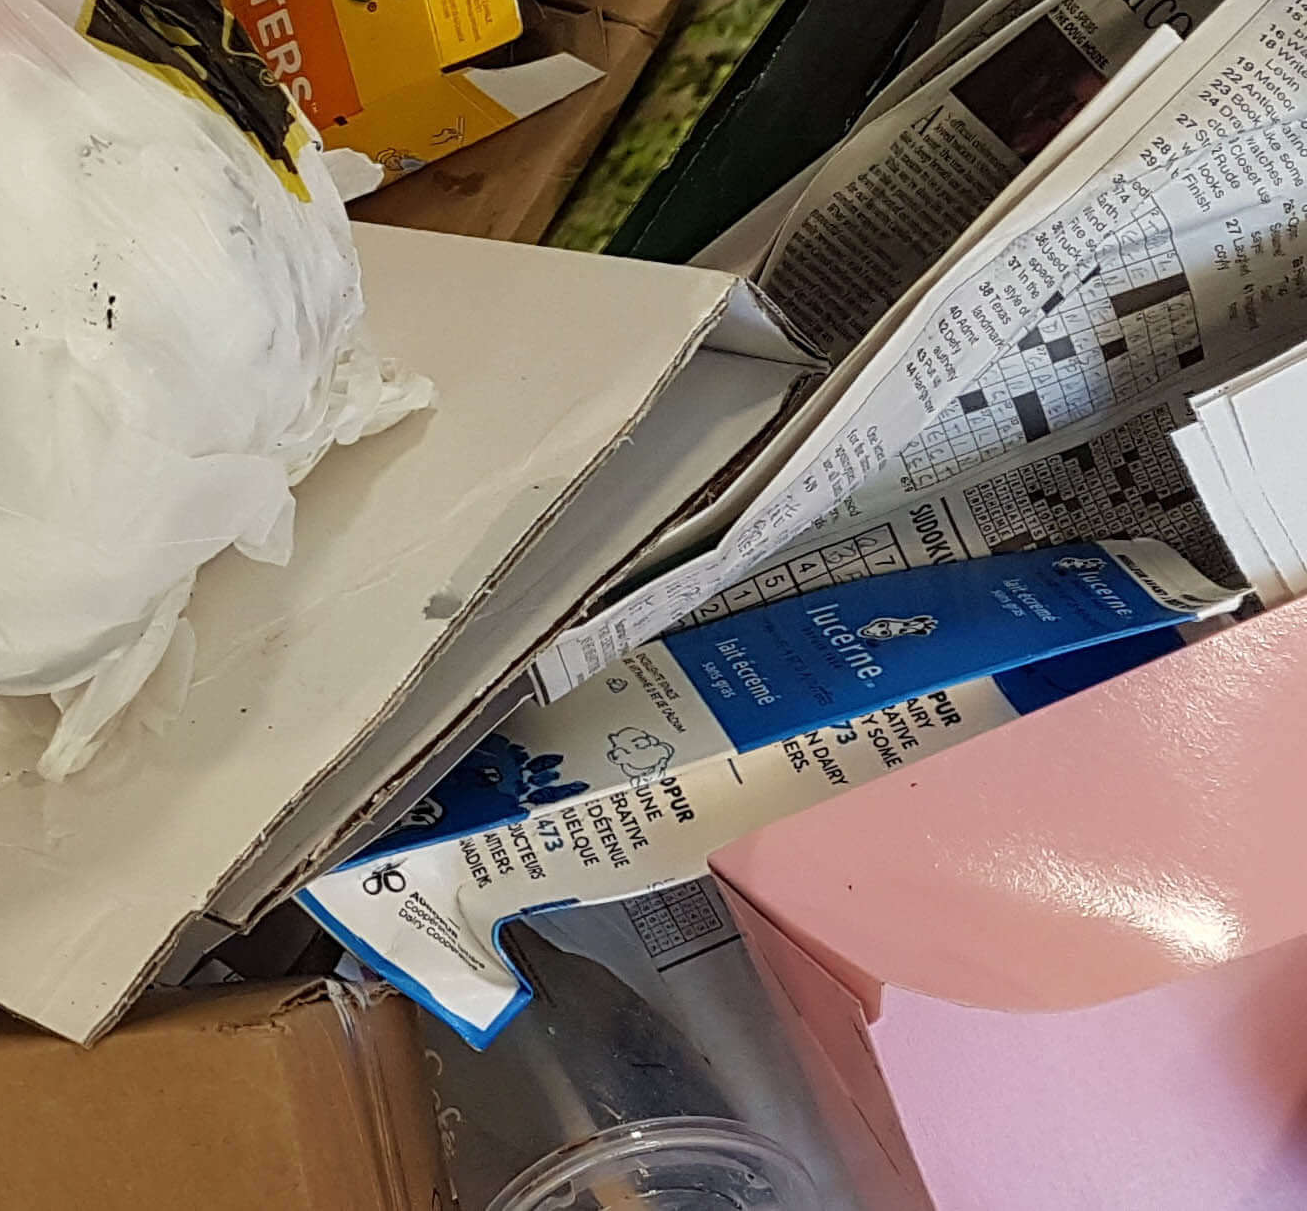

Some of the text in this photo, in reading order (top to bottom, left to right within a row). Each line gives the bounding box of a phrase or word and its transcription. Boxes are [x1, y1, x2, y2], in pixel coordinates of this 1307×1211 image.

[1221, 67, 1244, 85] 22
[1236, 56, 1255, 72] 19
[1198, 89, 1220, 107] 24
[1209, 78, 1233, 96] 23
[1175, 112, 1198, 130] 27
[1197, 162, 1226, 199] looks
[1213, 154, 1242, 190] Rude
[1279, 152, 1304, 187] some
[1181, 173, 1212, 214] Finish
[714, 637, 740, 662] lait
[805, 602, 883, 680] lucerne
[927, 690, 962, 727] PUR
[867, 726, 903, 768] SOME
[812, 744, 849, 786] DAIRY
[537, 818, 564, 853] 473
[587, 800, 630, 869] DÉTENUE
[398, 907, 425, 930] Dairy
